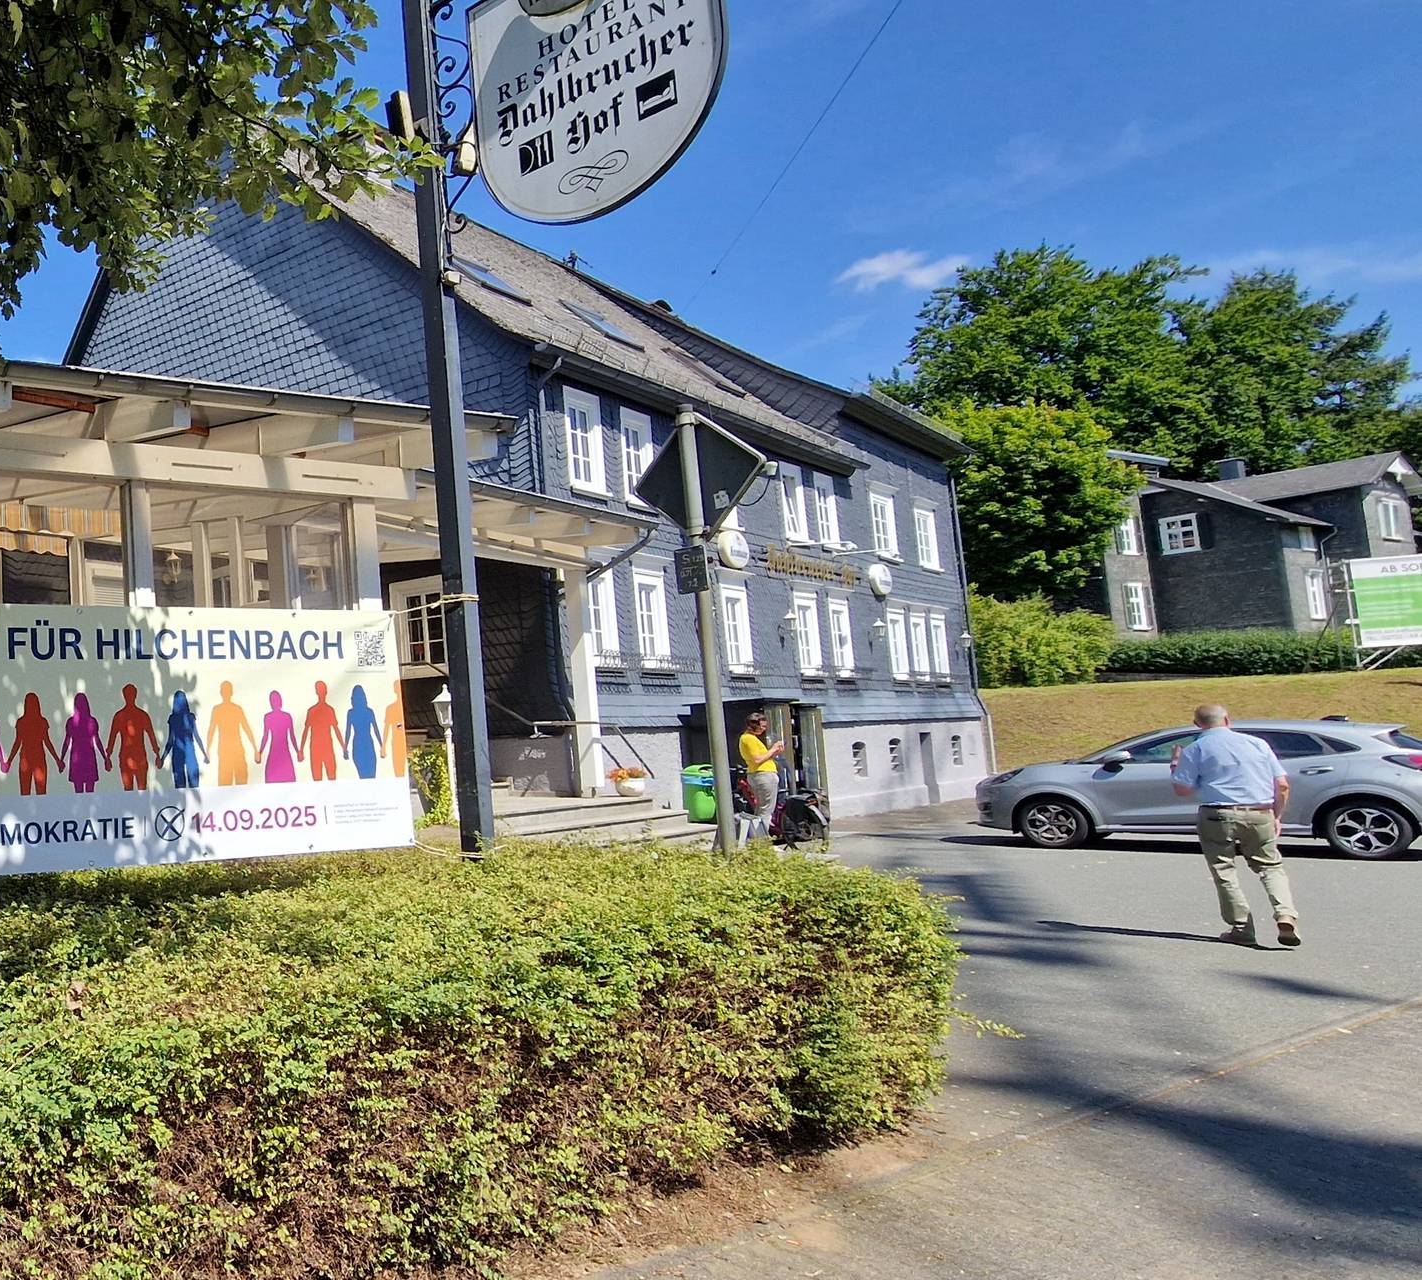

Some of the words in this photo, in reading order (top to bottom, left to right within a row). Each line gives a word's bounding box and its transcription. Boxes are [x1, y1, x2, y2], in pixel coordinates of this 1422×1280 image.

[538, 0, 636, 59] HOTEL
[497, 20, 695, 147] Dahlbrucher
[566, 91, 625, 154] Hof
[1381, 564, 1398, 573] AB
[1401, 562, 1422, 573] SO
[7, 619, 82, 660] FÜR
[96, 628, 345, 660] HILCHENBACH
[190, 805, 318, 834] 14.09.2025
